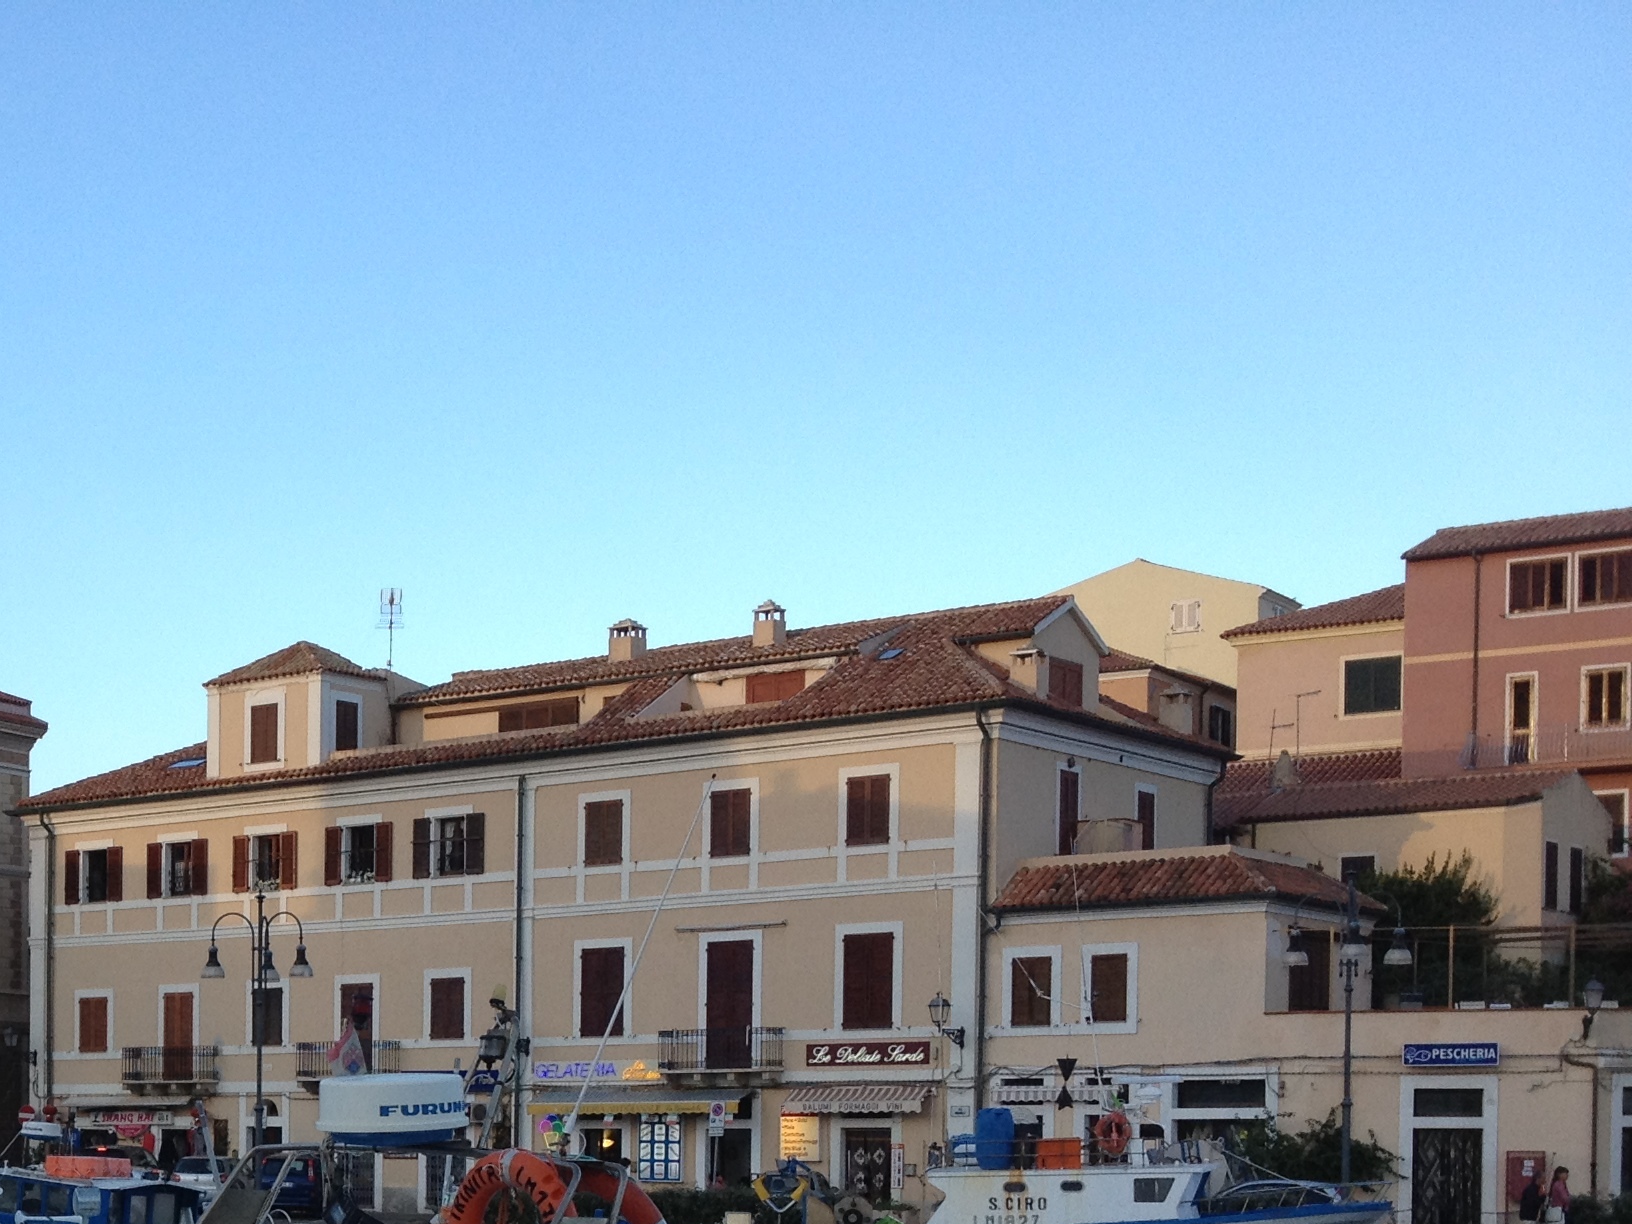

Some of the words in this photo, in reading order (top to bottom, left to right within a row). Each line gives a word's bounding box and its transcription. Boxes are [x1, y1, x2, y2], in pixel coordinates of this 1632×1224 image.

[808, 1046, 831, 1063] Le
[884, 1044, 925, 1062] Sarde
[1431, 1047, 1496, 1060] PESCHERIA
[802, 1103, 832, 1111] SALUMI
[838, 1103, 879, 1111] FORMAGGI
[886, 1102, 903, 1110] VINI
